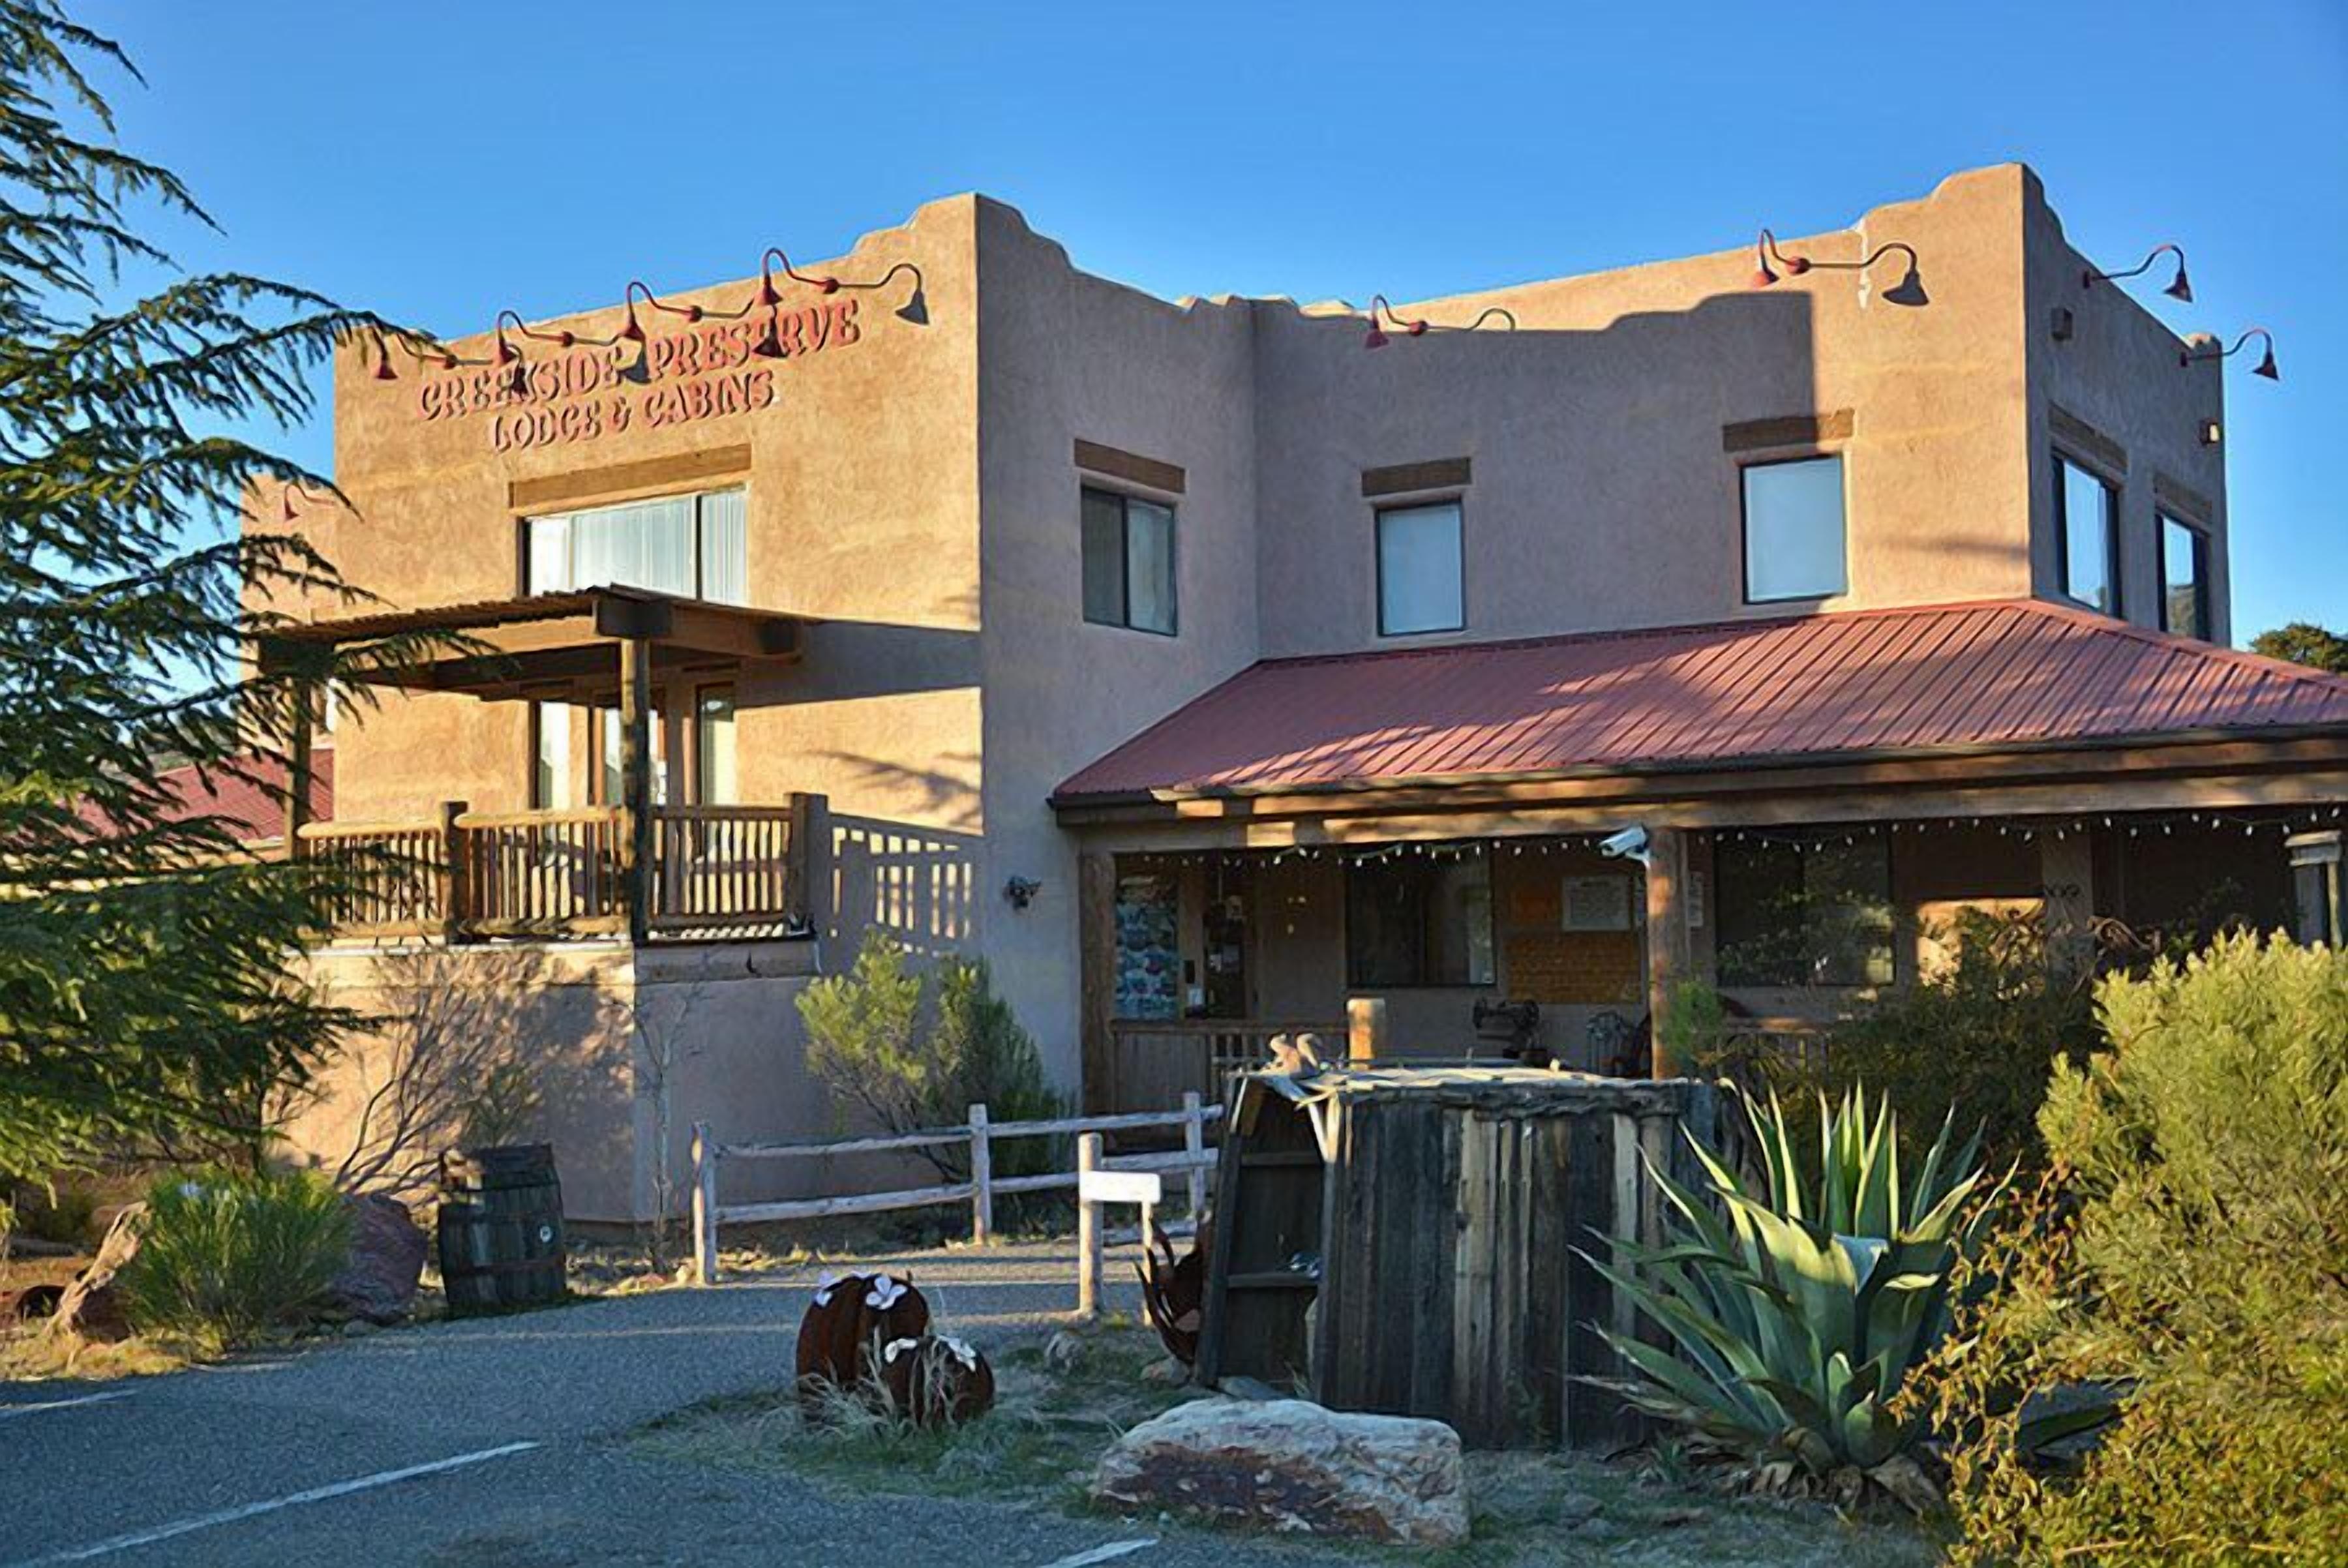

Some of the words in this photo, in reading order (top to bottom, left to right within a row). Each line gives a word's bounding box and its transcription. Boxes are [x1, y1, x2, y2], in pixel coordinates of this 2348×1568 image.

[494, 399, 603, 455] LODGE
[609, 395, 633, 433] &
[645, 369, 775, 428] CABINS
